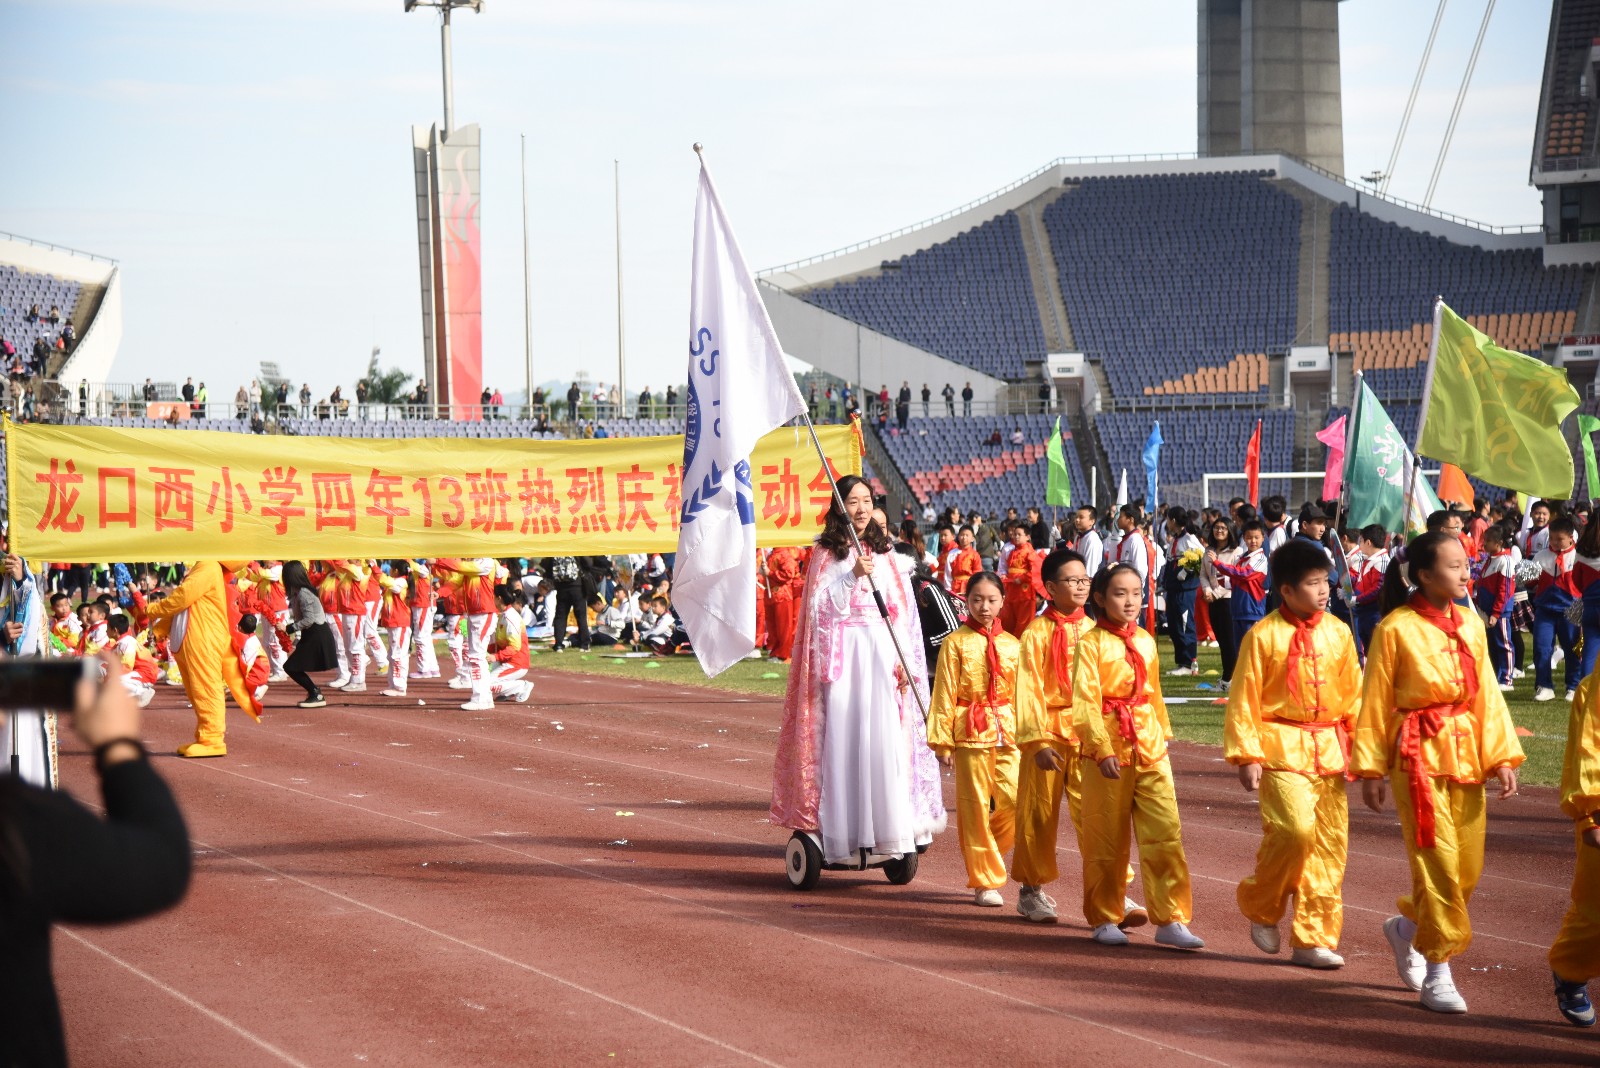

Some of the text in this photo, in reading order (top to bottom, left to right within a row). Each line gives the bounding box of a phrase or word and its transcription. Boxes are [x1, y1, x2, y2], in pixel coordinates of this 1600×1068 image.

[36, 457, 843, 536] 龙口西小学四年13班热烈庆动会
